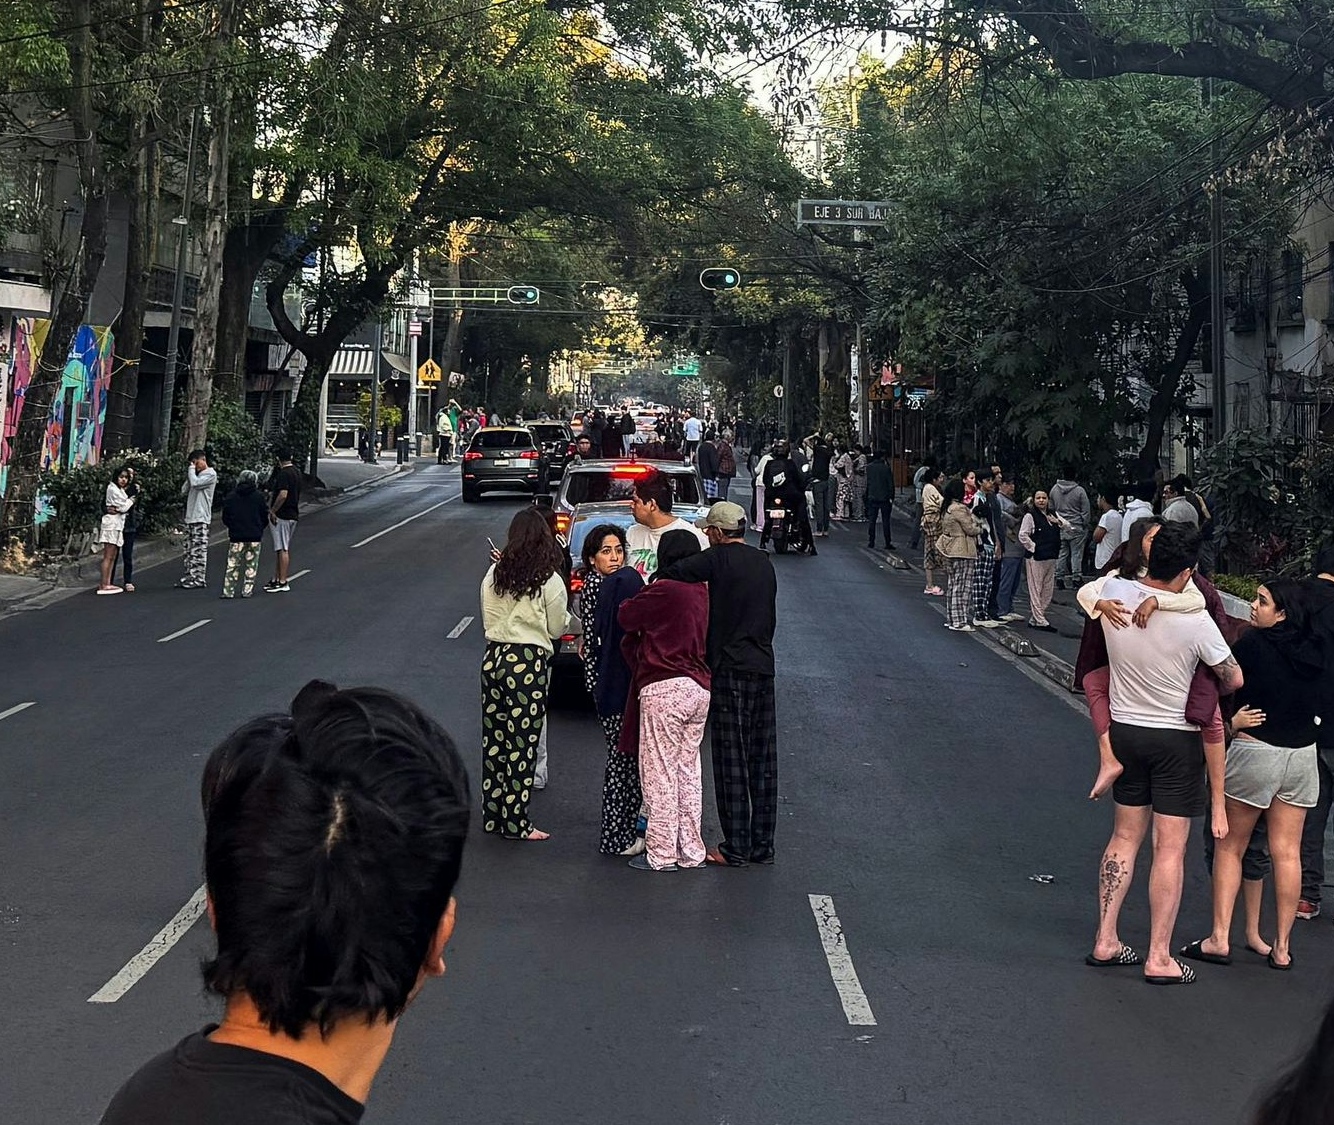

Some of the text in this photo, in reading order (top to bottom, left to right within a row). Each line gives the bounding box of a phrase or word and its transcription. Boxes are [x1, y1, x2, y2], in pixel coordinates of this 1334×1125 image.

[814, 206, 830, 218] EJE
[835, 207, 841, 218] 3
[847, 207, 864, 219] SUR
